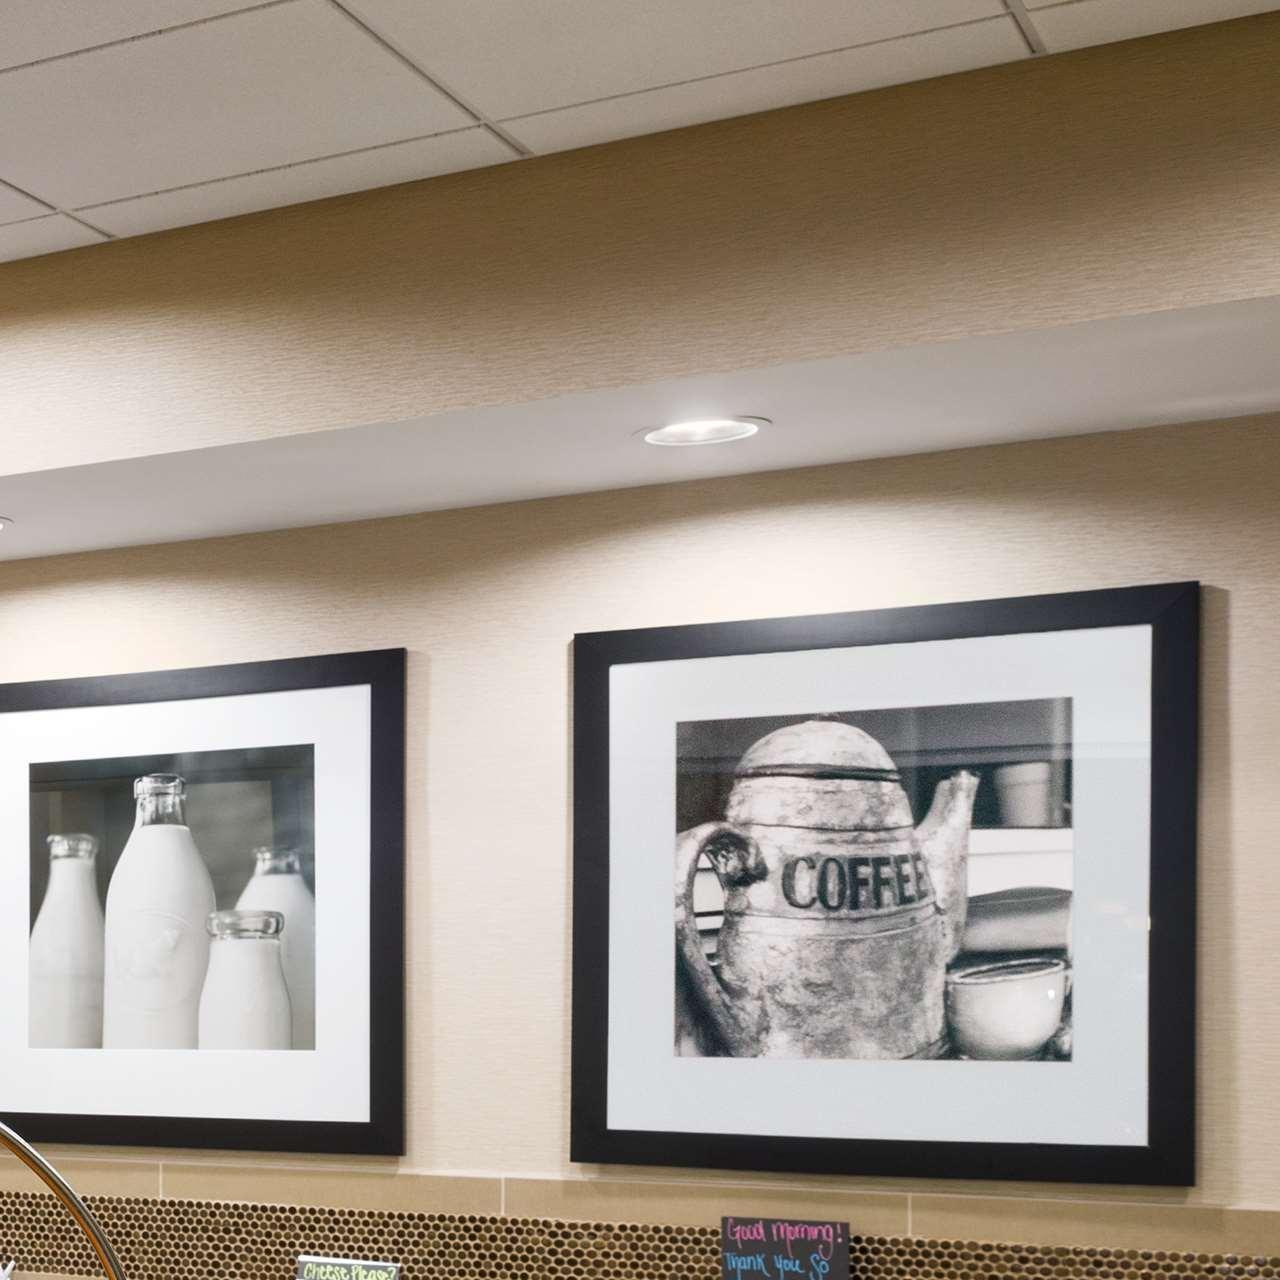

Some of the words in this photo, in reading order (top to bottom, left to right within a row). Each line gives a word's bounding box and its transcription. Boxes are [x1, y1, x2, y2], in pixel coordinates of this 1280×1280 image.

[781, 852, 930, 911] COFFEE
[727, 1217, 767, 1249] Good
[723, 1252, 771, 1279] Thank
